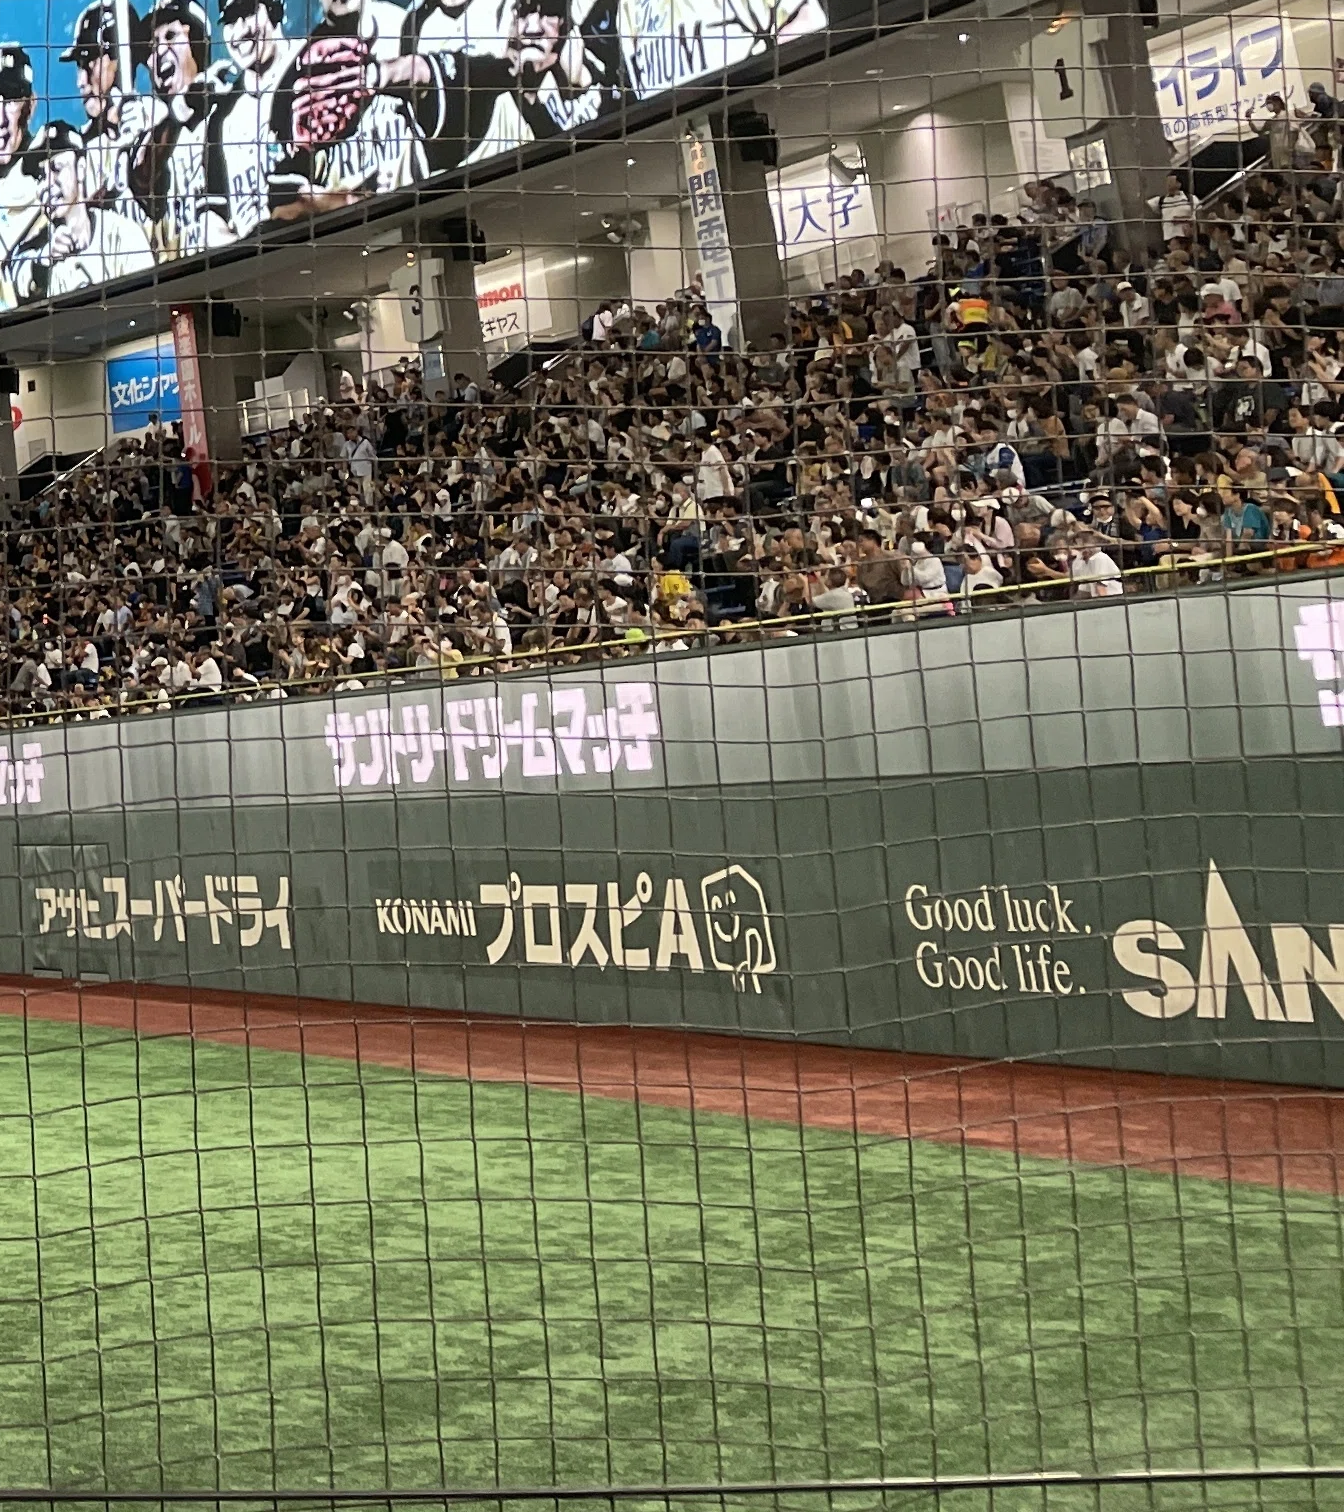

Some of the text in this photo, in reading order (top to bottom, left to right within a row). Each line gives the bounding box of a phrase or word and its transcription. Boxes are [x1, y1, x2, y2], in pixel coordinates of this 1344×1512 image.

[1054, 57, 1073, 100] 1
[771, 187, 864, 243] 大学
[409, 285, 421, 315] 3
[323, 682, 660, 788] サントリードリームマッチ
[375, 898, 477, 937] KONAMI
[479, 871, 704, 973] プロスピA
[904, 883, 1092, 935] Good luck.
[915, 941, 1087, 995] Good life.
